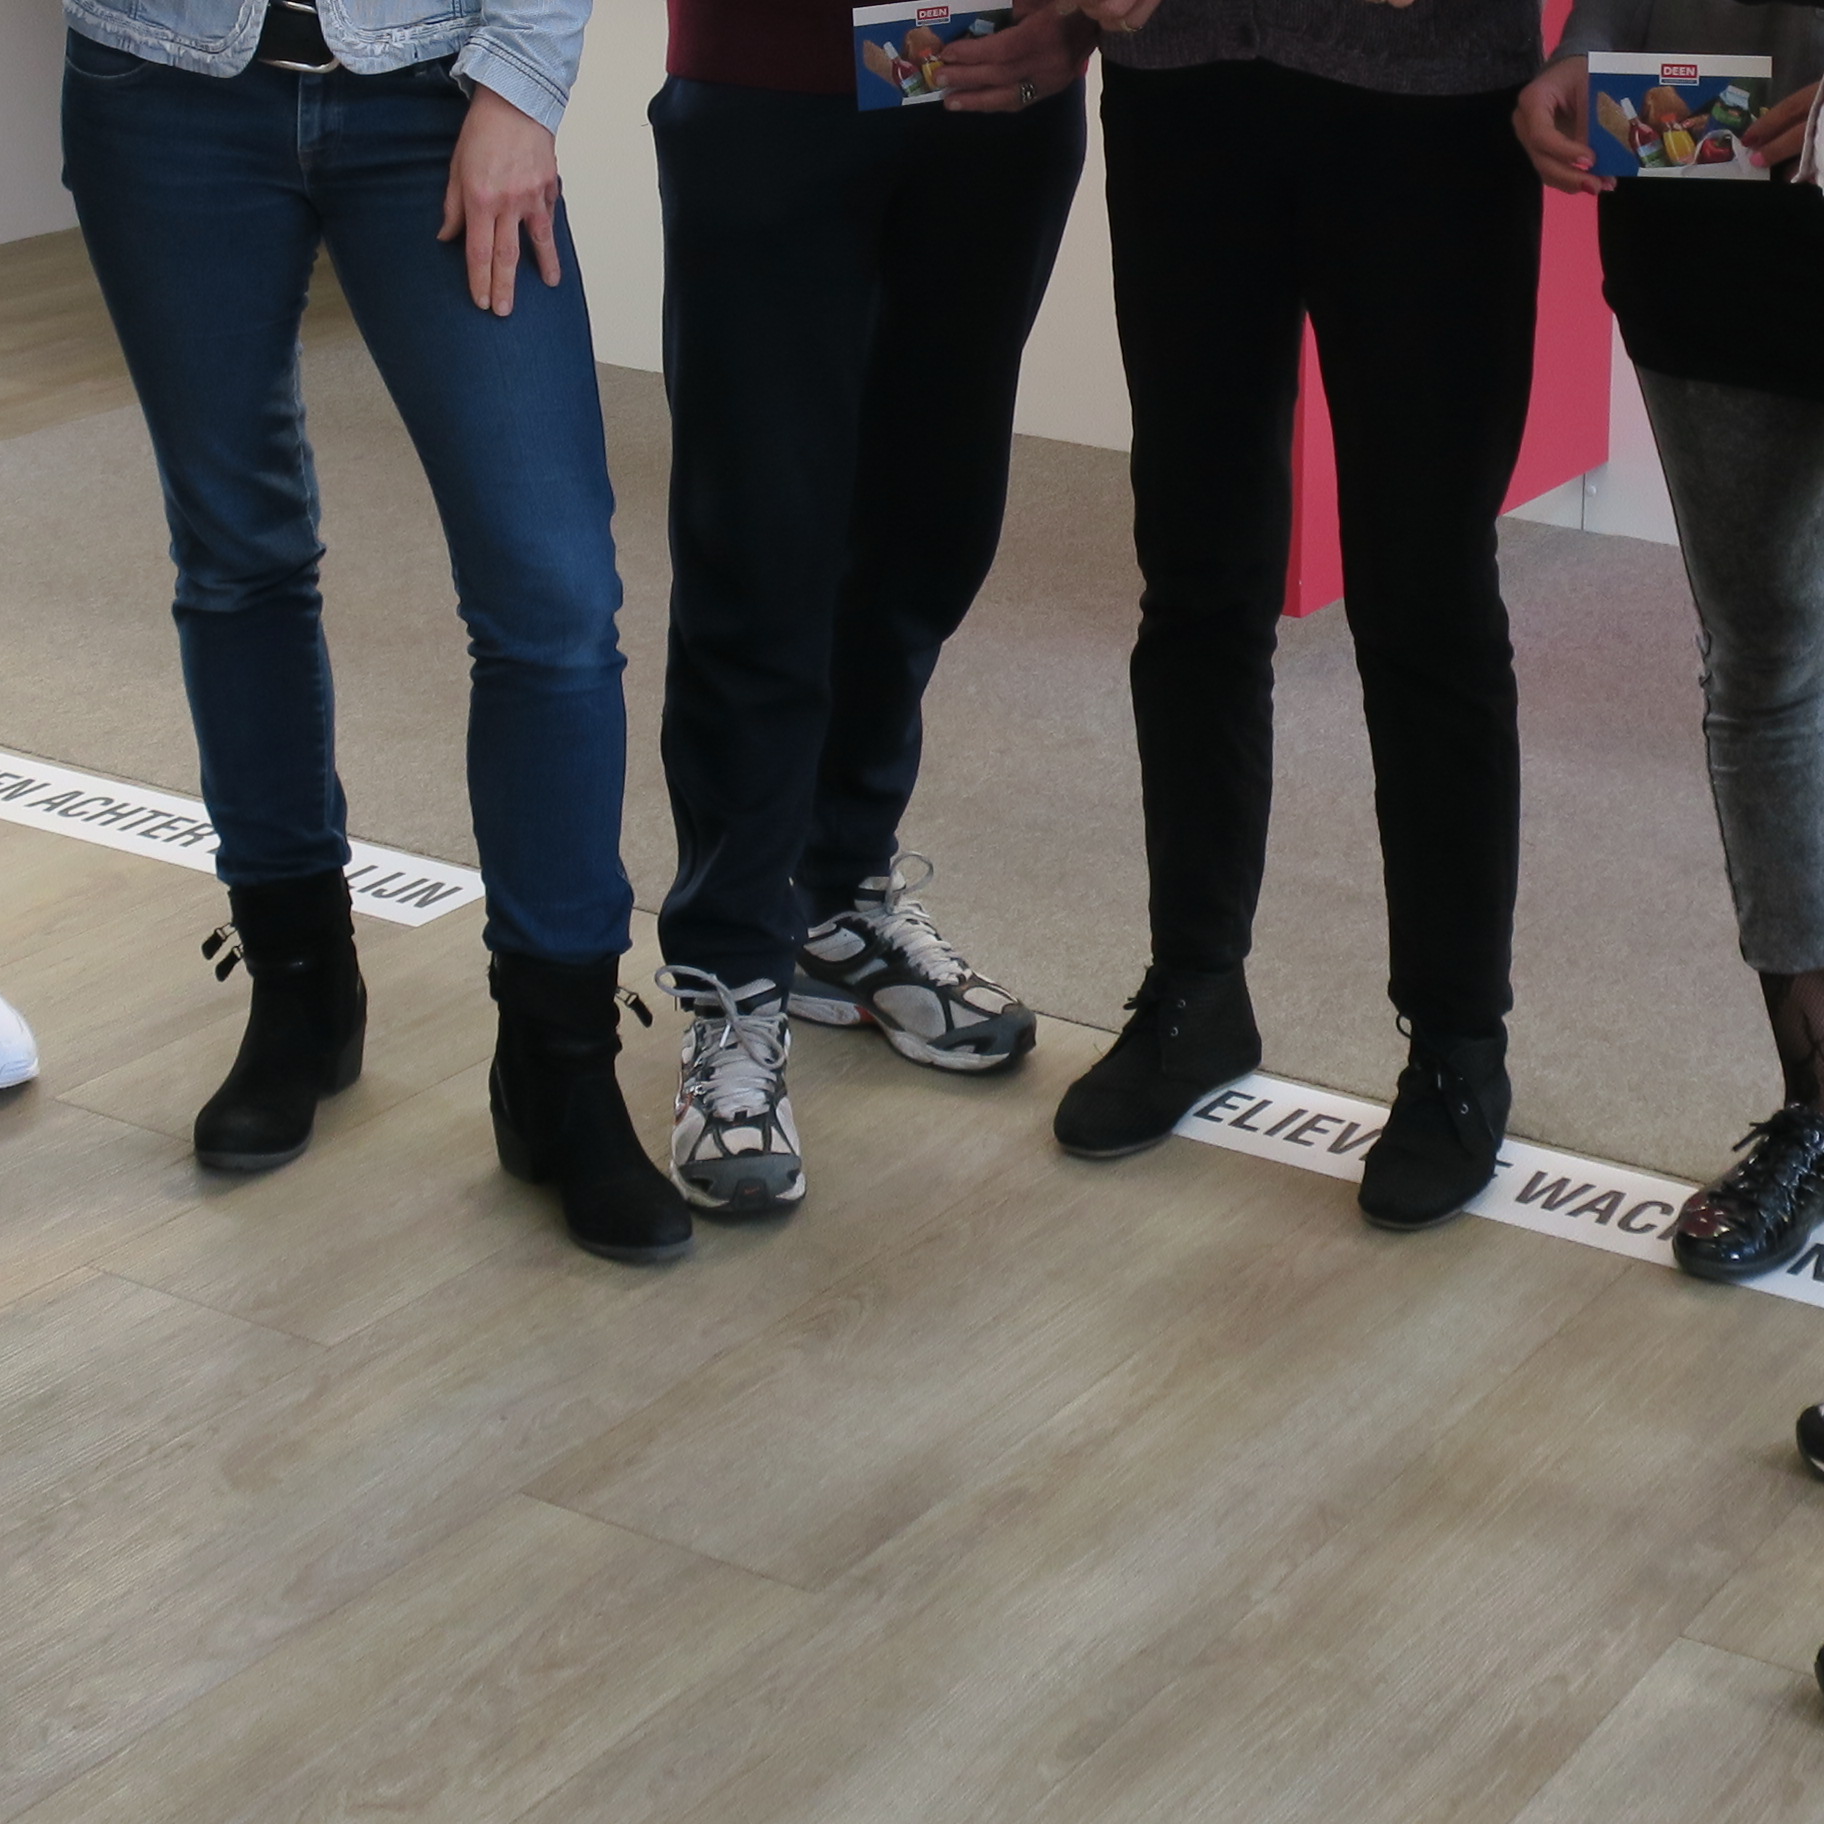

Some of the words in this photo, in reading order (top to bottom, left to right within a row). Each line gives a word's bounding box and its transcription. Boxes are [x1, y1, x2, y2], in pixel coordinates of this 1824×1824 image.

[919, 8, 947, 19] DEEN
[1663, 66, 1695, 76] DEEN
[24, 789, 218, 848] ACHTER
[1193, 1090, 1382, 1161] ELIEV
